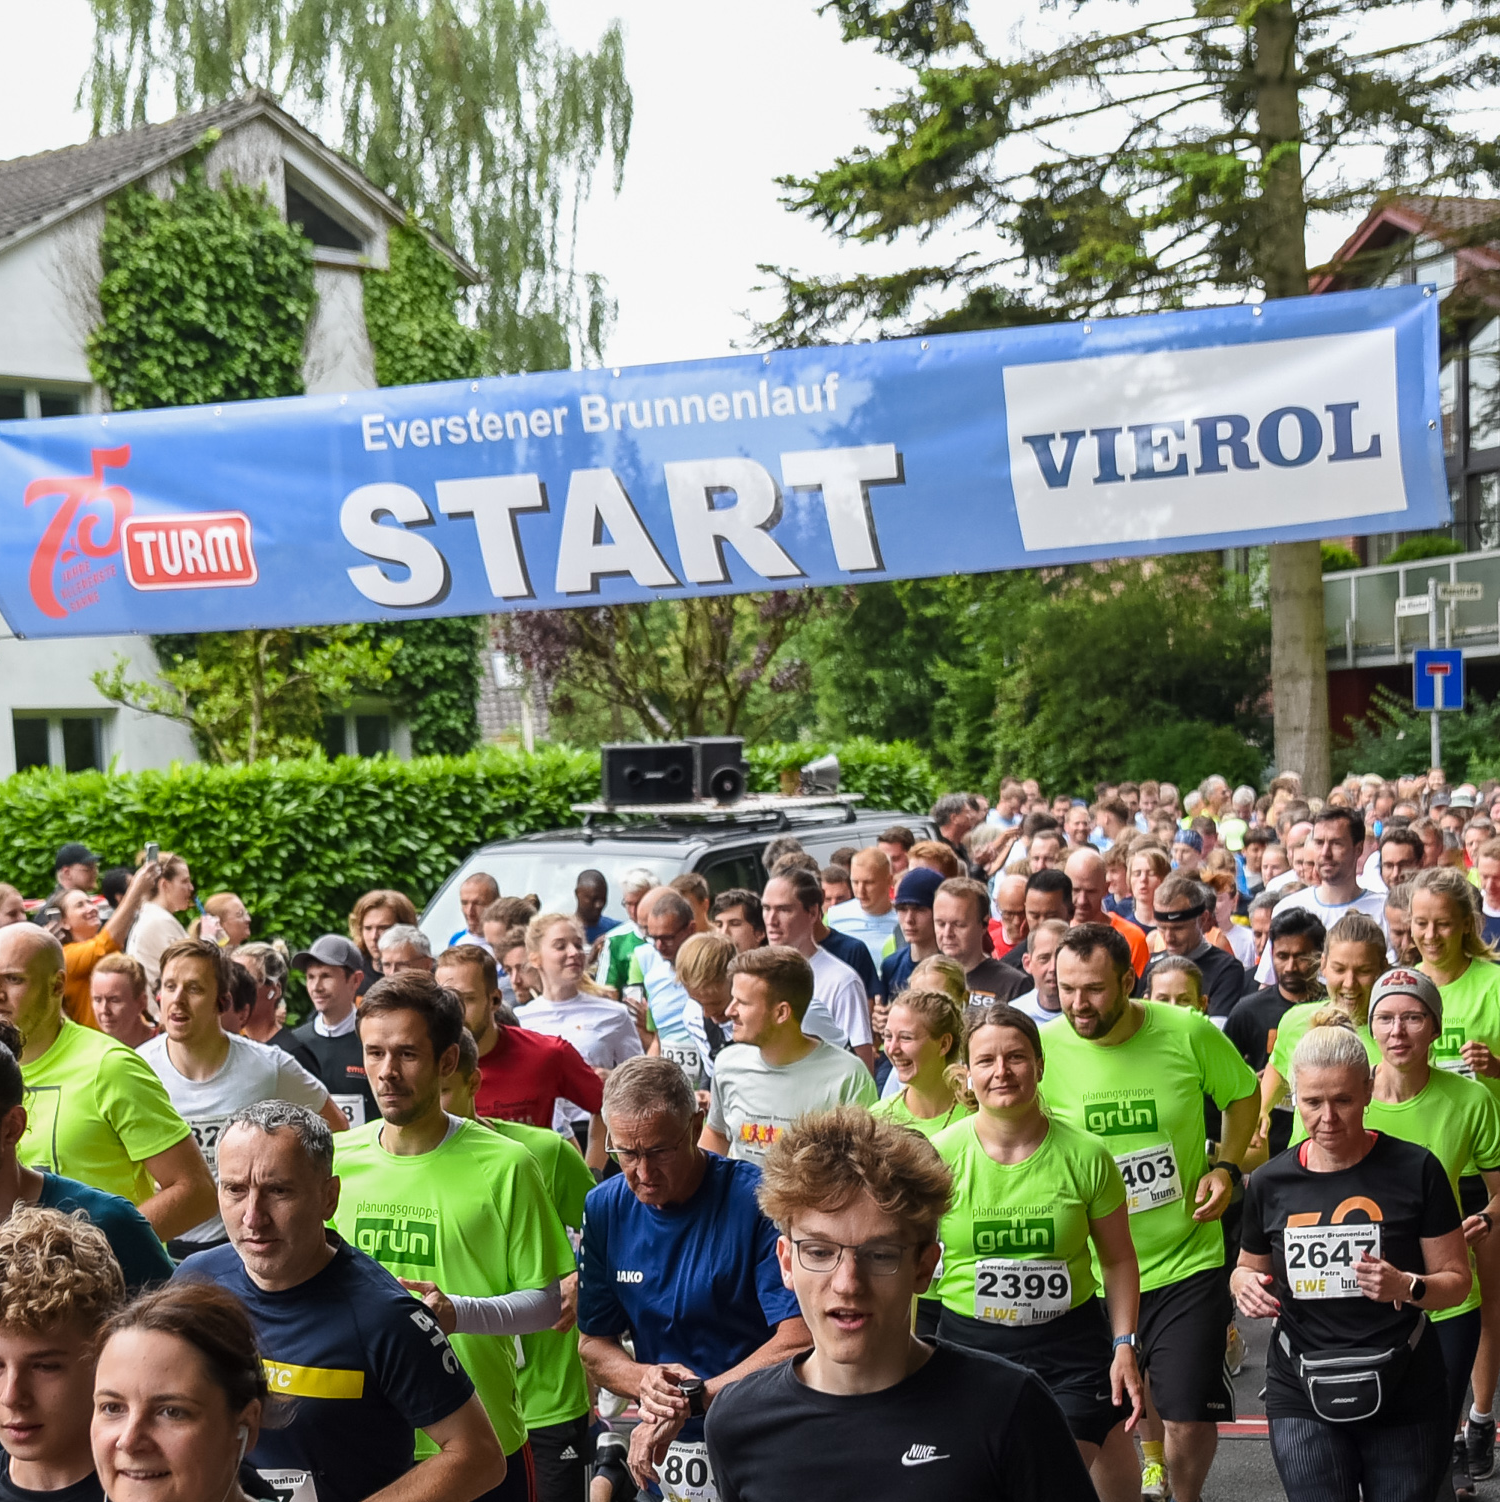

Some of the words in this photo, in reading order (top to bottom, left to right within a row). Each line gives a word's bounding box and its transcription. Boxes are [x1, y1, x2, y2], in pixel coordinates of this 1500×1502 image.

[361, 406, 569, 451] Everstener
[579, 372, 840, 434] Brunnenlauf
[1022, 402, 1382, 489] VIEROL
[24, 443, 134, 619] 75
[339, 443, 902, 608] START
[133, 525, 244, 577] TURM
[1082, 1087, 1155, 1102] planungsgruppe
[1088, 1101, 1152, 1134] grün
[1121, 1156, 1176, 1187] 403
[1150, 1187, 1176, 1201] bruns
[356, 1201, 439, 1220] planungsgruppe
[973, 1204, 1054, 1218] planungsgruppe
[357, 1219, 430, 1256] grün
[976, 1218, 1049, 1253] grün
[1327, 1230, 1373, 1239] Brunnenlauf
[1288, 1239, 1377, 1269] 2647
[617, 1270, 644, 1283] JAKO
[977, 1272, 1068, 1299] 2399
[1295, 1279, 1327, 1293] EWE
[1341, 1277, 1359, 1290] bru
[983, 1306, 1018, 1321] EWE
[410, 1308, 460, 1375] BTC
[264, 1367, 292, 1388] TC
[669, 1446, 695, 1455] erstener
[908, 1443, 937, 1459] NIKE
[266, 1474, 306, 1486] nenlauf
[664, 1455, 717, 1487] 80
